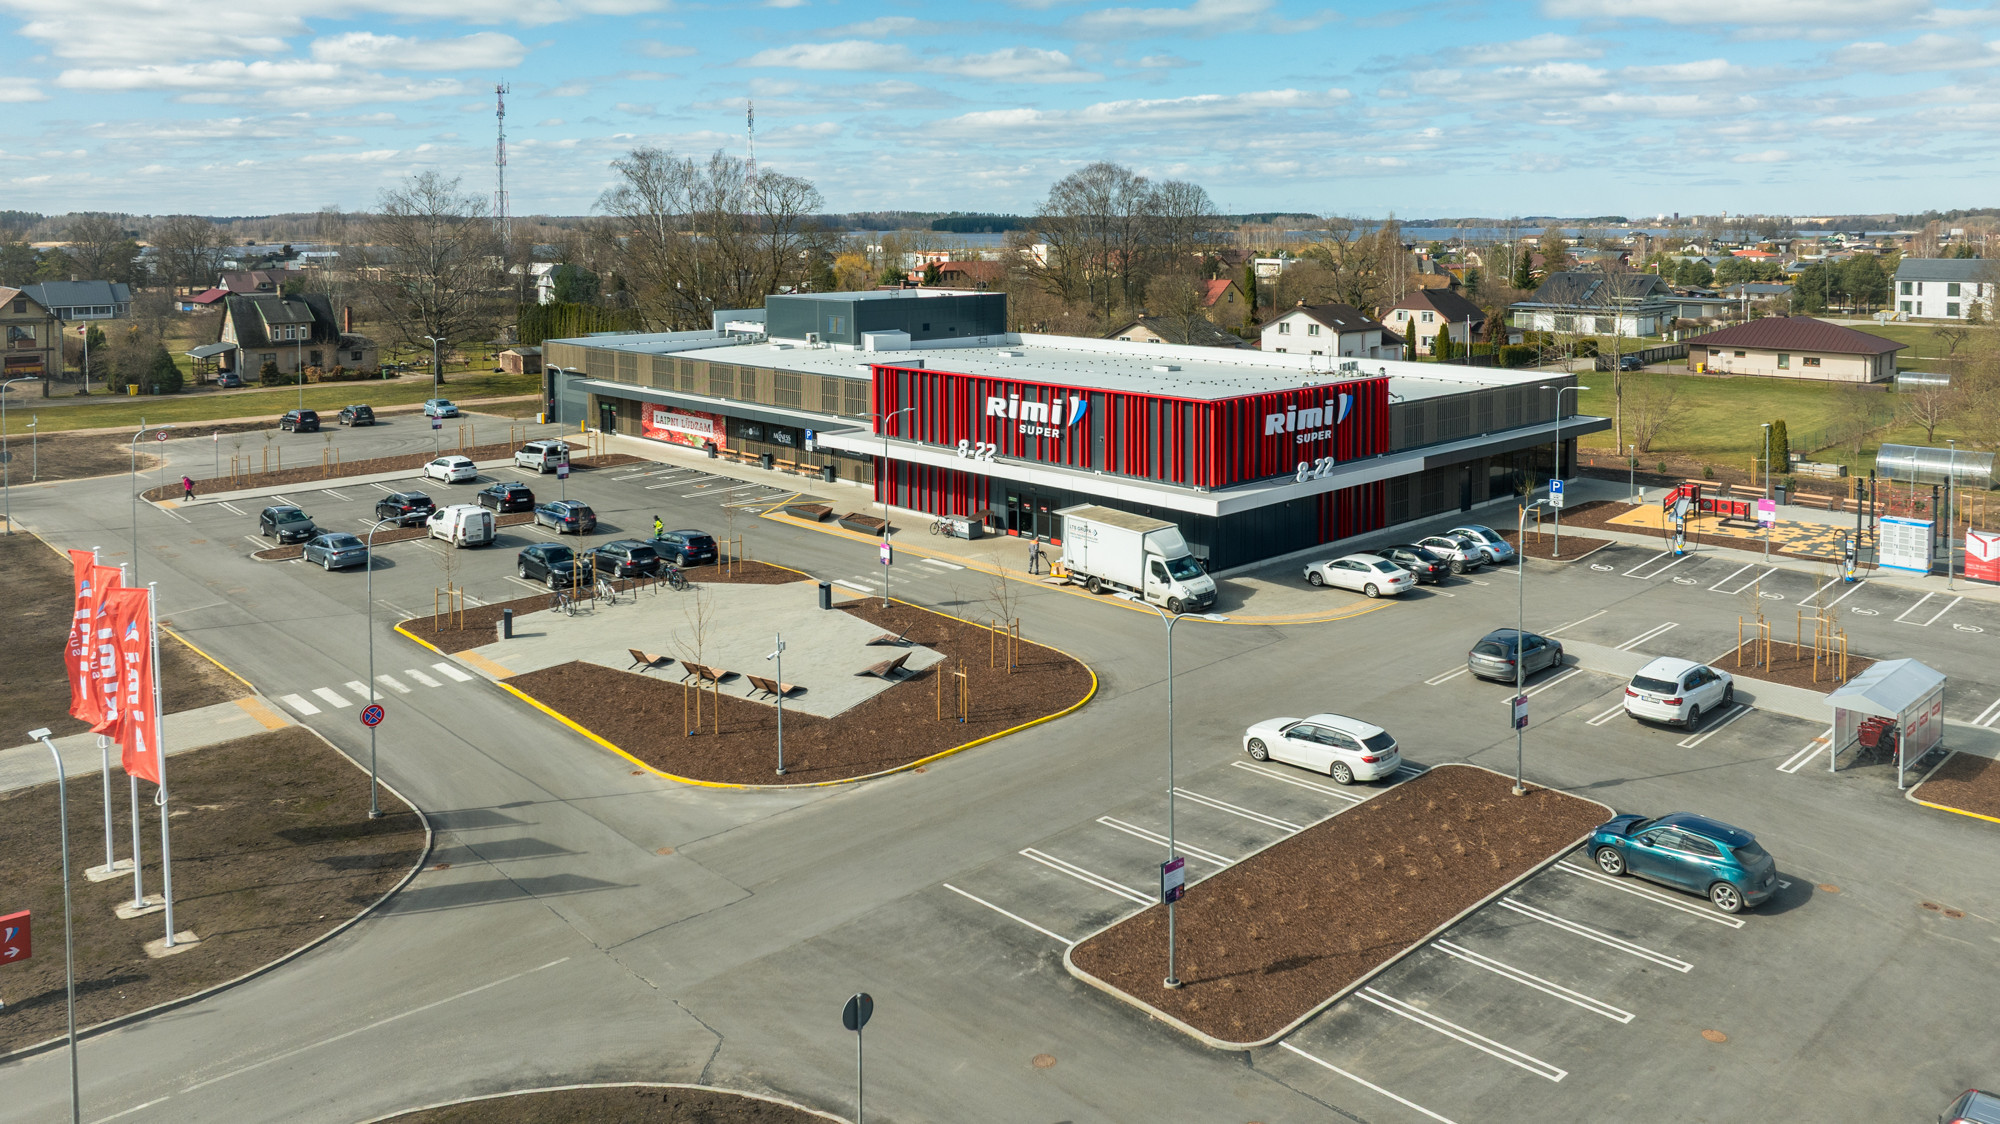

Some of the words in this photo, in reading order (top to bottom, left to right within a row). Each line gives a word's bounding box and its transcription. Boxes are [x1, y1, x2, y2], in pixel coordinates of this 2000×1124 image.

[986, 394, 1062, 425] Rimi
[1265, 399, 1334, 436] Rimi
[655, 414, 679, 427] LAIPNI
[681, 418, 711, 434] LŪDZAM
[806, 430, 812, 438] P
[1019, 425, 1060, 438] SUPER
[1296, 430, 1332, 444] SUPER
[957, 439, 997, 463] 8-22
[1296, 456, 1335, 483] 8-22
[1552, 481, 1561, 492] P
